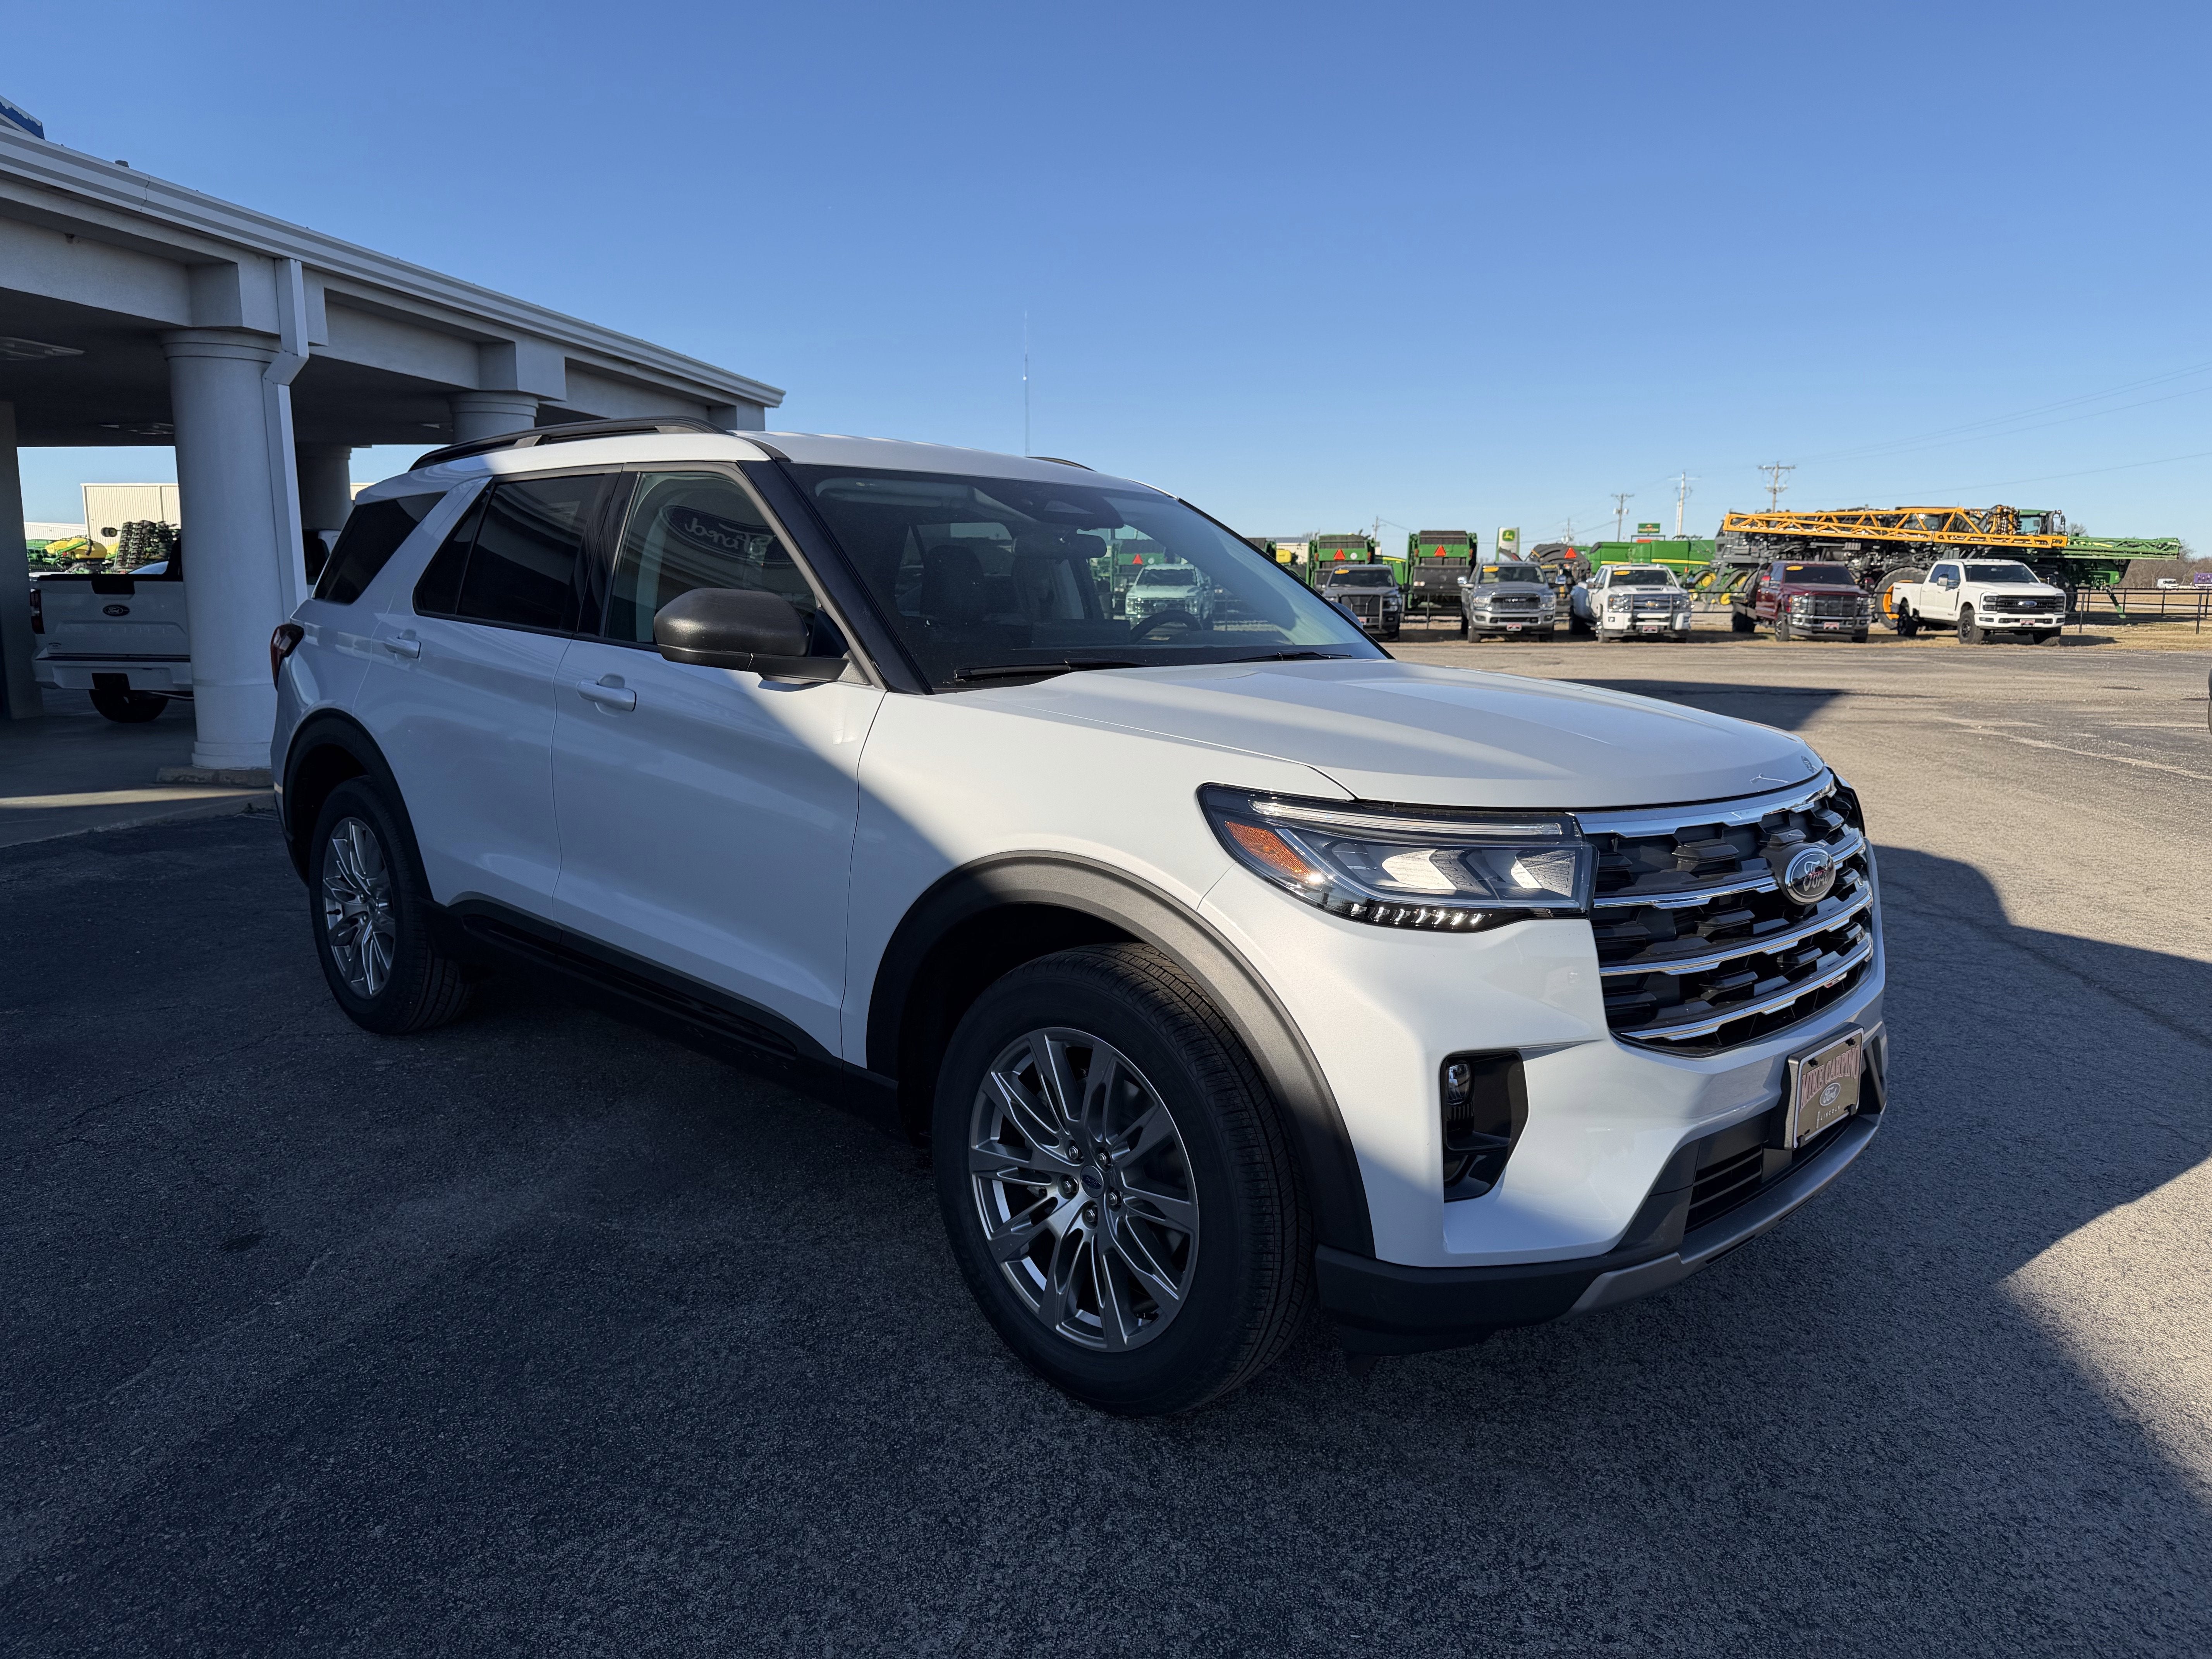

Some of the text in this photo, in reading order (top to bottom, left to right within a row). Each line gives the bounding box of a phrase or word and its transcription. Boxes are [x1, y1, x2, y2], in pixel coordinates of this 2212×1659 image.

[1803, 859, 1829, 891] Ford
[1800, 1044, 1860, 1113] MIKE CARPINO
[1823, 1086, 1837, 1103] Ford
[1820, 1105, 1841, 1120] LINCOLN
